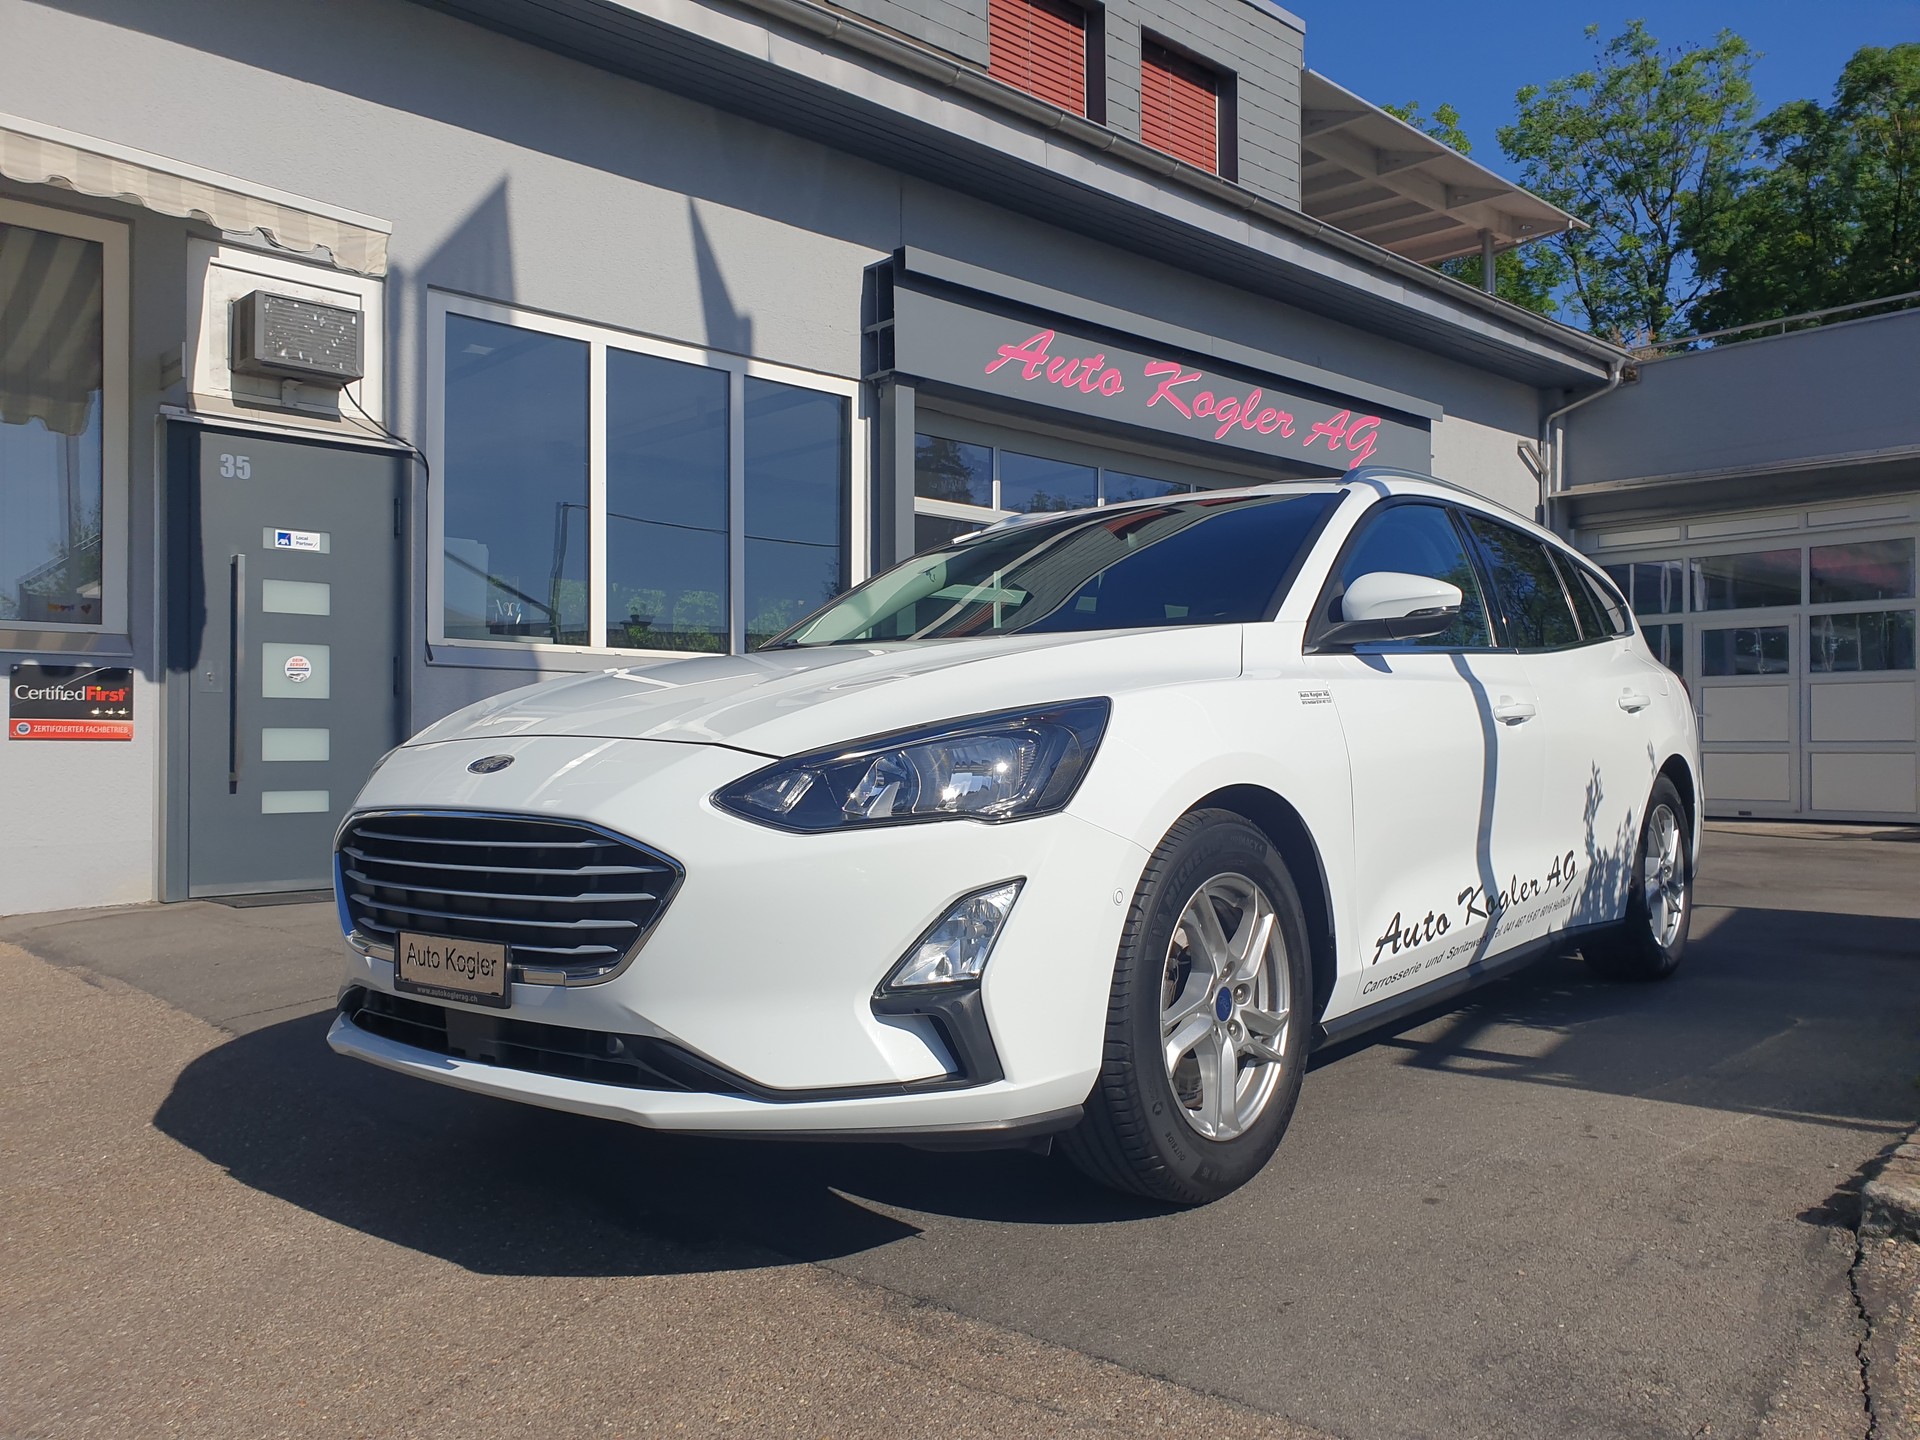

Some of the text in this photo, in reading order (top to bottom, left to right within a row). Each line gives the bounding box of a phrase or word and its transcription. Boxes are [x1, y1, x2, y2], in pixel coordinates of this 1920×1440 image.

[985, 329, 1382, 470] Auto Kogler AG
[219, 453, 251, 481] 35
[33, 725, 84, 733] ZERTIFIZIERTER
[85, 725, 129, 734] FACHBETRIEB
[1372, 849, 1579, 966] Auto Kogler AG
[406, 942, 497, 980] Auto Kogler
[1362, 961, 1422, 995] Carrosserie
[1425, 950, 1446, 969] und
[1446, 931, 1490, 961] Spritzwerk
[416, 987, 478, 1002] www.autokoglerag.ch
